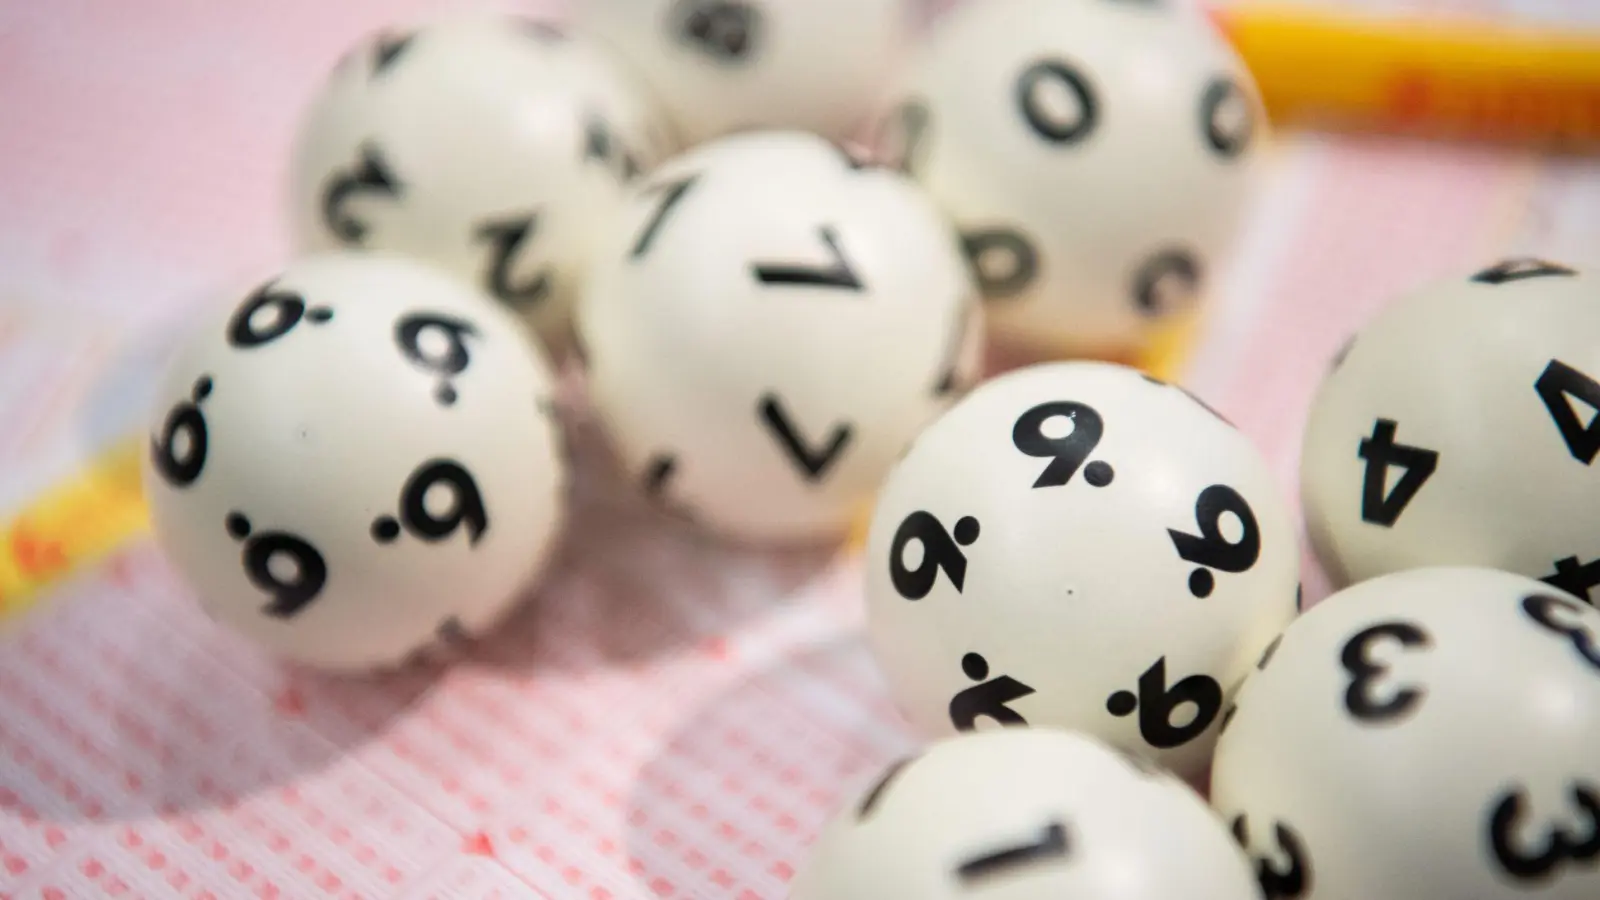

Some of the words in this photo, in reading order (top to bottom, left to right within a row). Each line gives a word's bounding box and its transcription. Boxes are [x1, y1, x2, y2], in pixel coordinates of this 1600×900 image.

[1012, 60, 1100, 147] 0
[319, 145, 402, 244] 2
[473, 211, 555, 304] 2
[1357, 417, 1440, 528] 4
[1339, 620, 1435, 724] 3
[1489, 778, 1600, 882] 3
